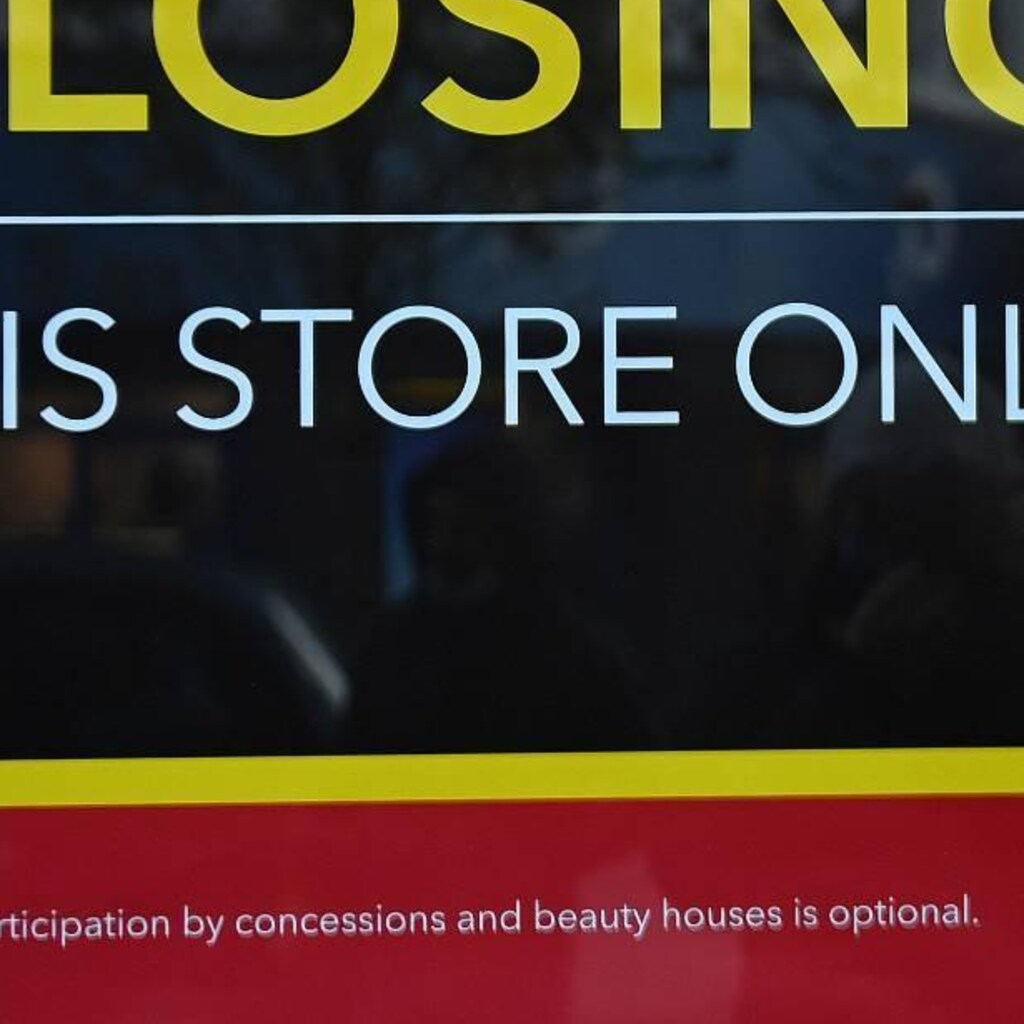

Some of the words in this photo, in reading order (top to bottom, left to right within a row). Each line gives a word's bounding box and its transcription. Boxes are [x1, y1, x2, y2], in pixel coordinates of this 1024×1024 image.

[2, 307, 118, 432] IS
[176, 305, 680, 432] STORE
[0, 909, 170, 948] rticipation
[183, 904, 225, 946] by
[235, 903, 446, 939] concessions
[457, 899, 521, 934] and
[534, 898, 650, 939] beauty
[662, 896, 782, 931] houses
[794, 896, 818, 929] is
[828, 893, 982, 935] optional.
